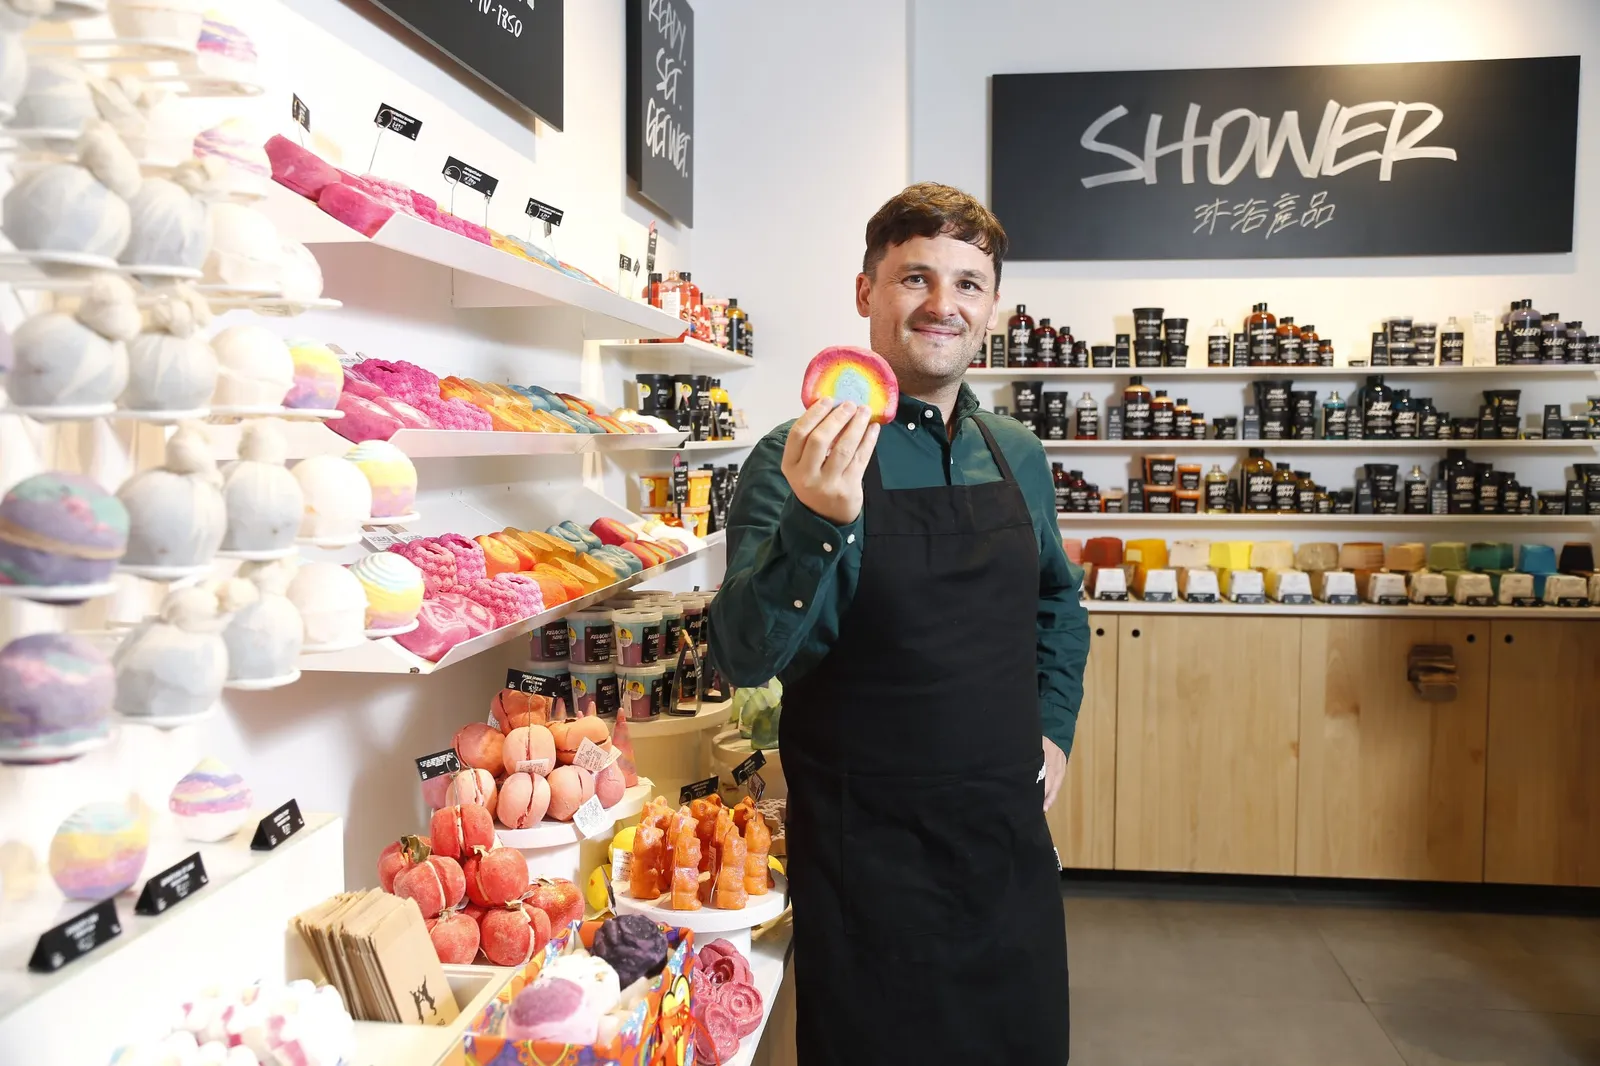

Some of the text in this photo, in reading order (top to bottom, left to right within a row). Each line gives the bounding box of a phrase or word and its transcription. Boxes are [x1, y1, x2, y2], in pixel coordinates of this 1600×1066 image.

[648, 0, 687, 67] READY.
[655, 47, 683, 111] SET.
[645, 97, 692, 179] GET WET.
[1080, 99, 1457, 189] SHOWER
[1192, 190, 1336, 240] 沐浴產品
[1250, 476, 1273, 485] HAPPY
